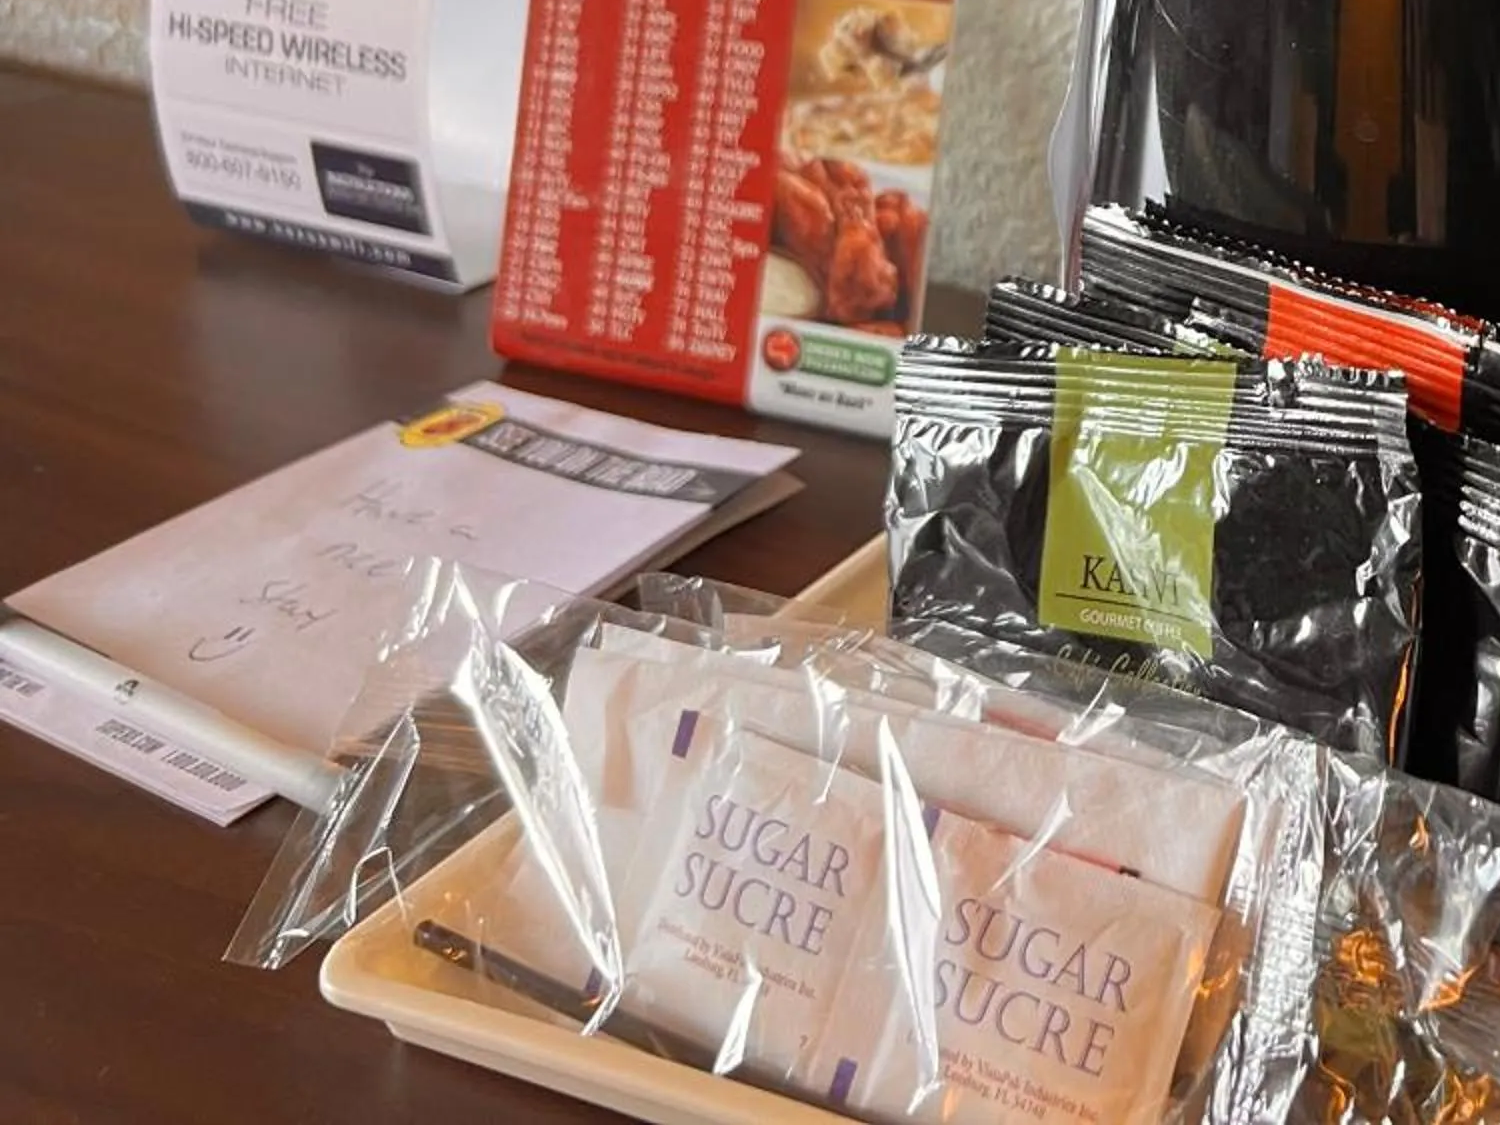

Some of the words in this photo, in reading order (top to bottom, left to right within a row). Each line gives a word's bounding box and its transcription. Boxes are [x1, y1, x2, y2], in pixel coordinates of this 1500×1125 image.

[168, 11, 274, 57] HI-SPEED
[280, 30, 408, 83] WIRELESS
[224, 55, 350, 98] INTERNET
[1079, 607, 1142, 633] GOURMET
[695, 793, 851, 898] SUGAR
[674, 851, 835, 957] SUCRE
[945, 897, 1133, 1014] SUGAR
[934, 958, 1116, 1079] SUCRE
